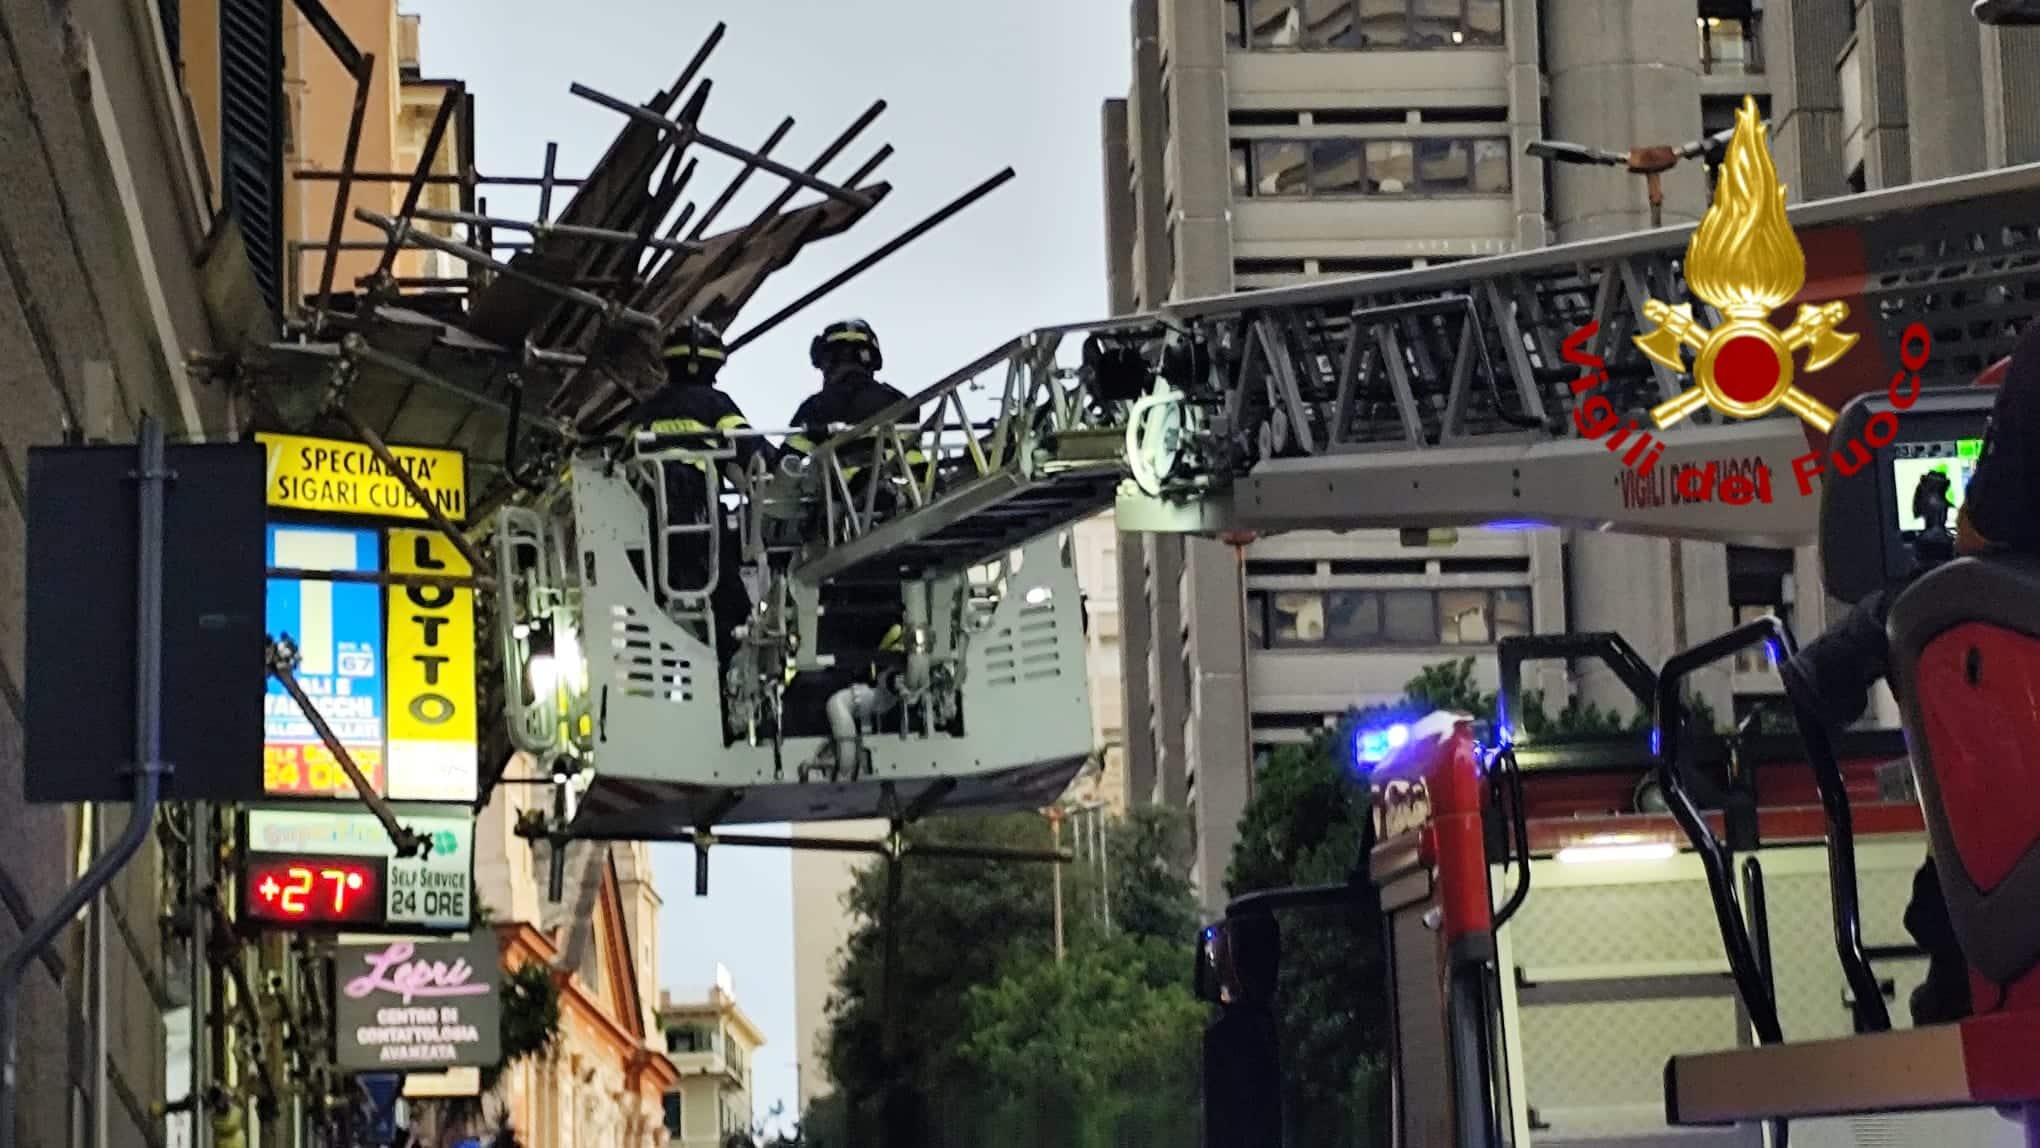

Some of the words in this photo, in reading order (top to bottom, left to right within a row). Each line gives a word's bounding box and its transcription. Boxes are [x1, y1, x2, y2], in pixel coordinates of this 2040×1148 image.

[301, 447, 438, 480] SPECIALTA'
[279, 475, 358, 506] SIGARI
[406, 536, 456, 724] LOTTO
[420, 867, 466, 888] SERVICE
[391, 890, 417, 915] 24
[424, 891, 465, 916] ORE
[376, 1007, 438, 1025] CENTRO
[379, 1044, 457, 1062] AVANZATA
